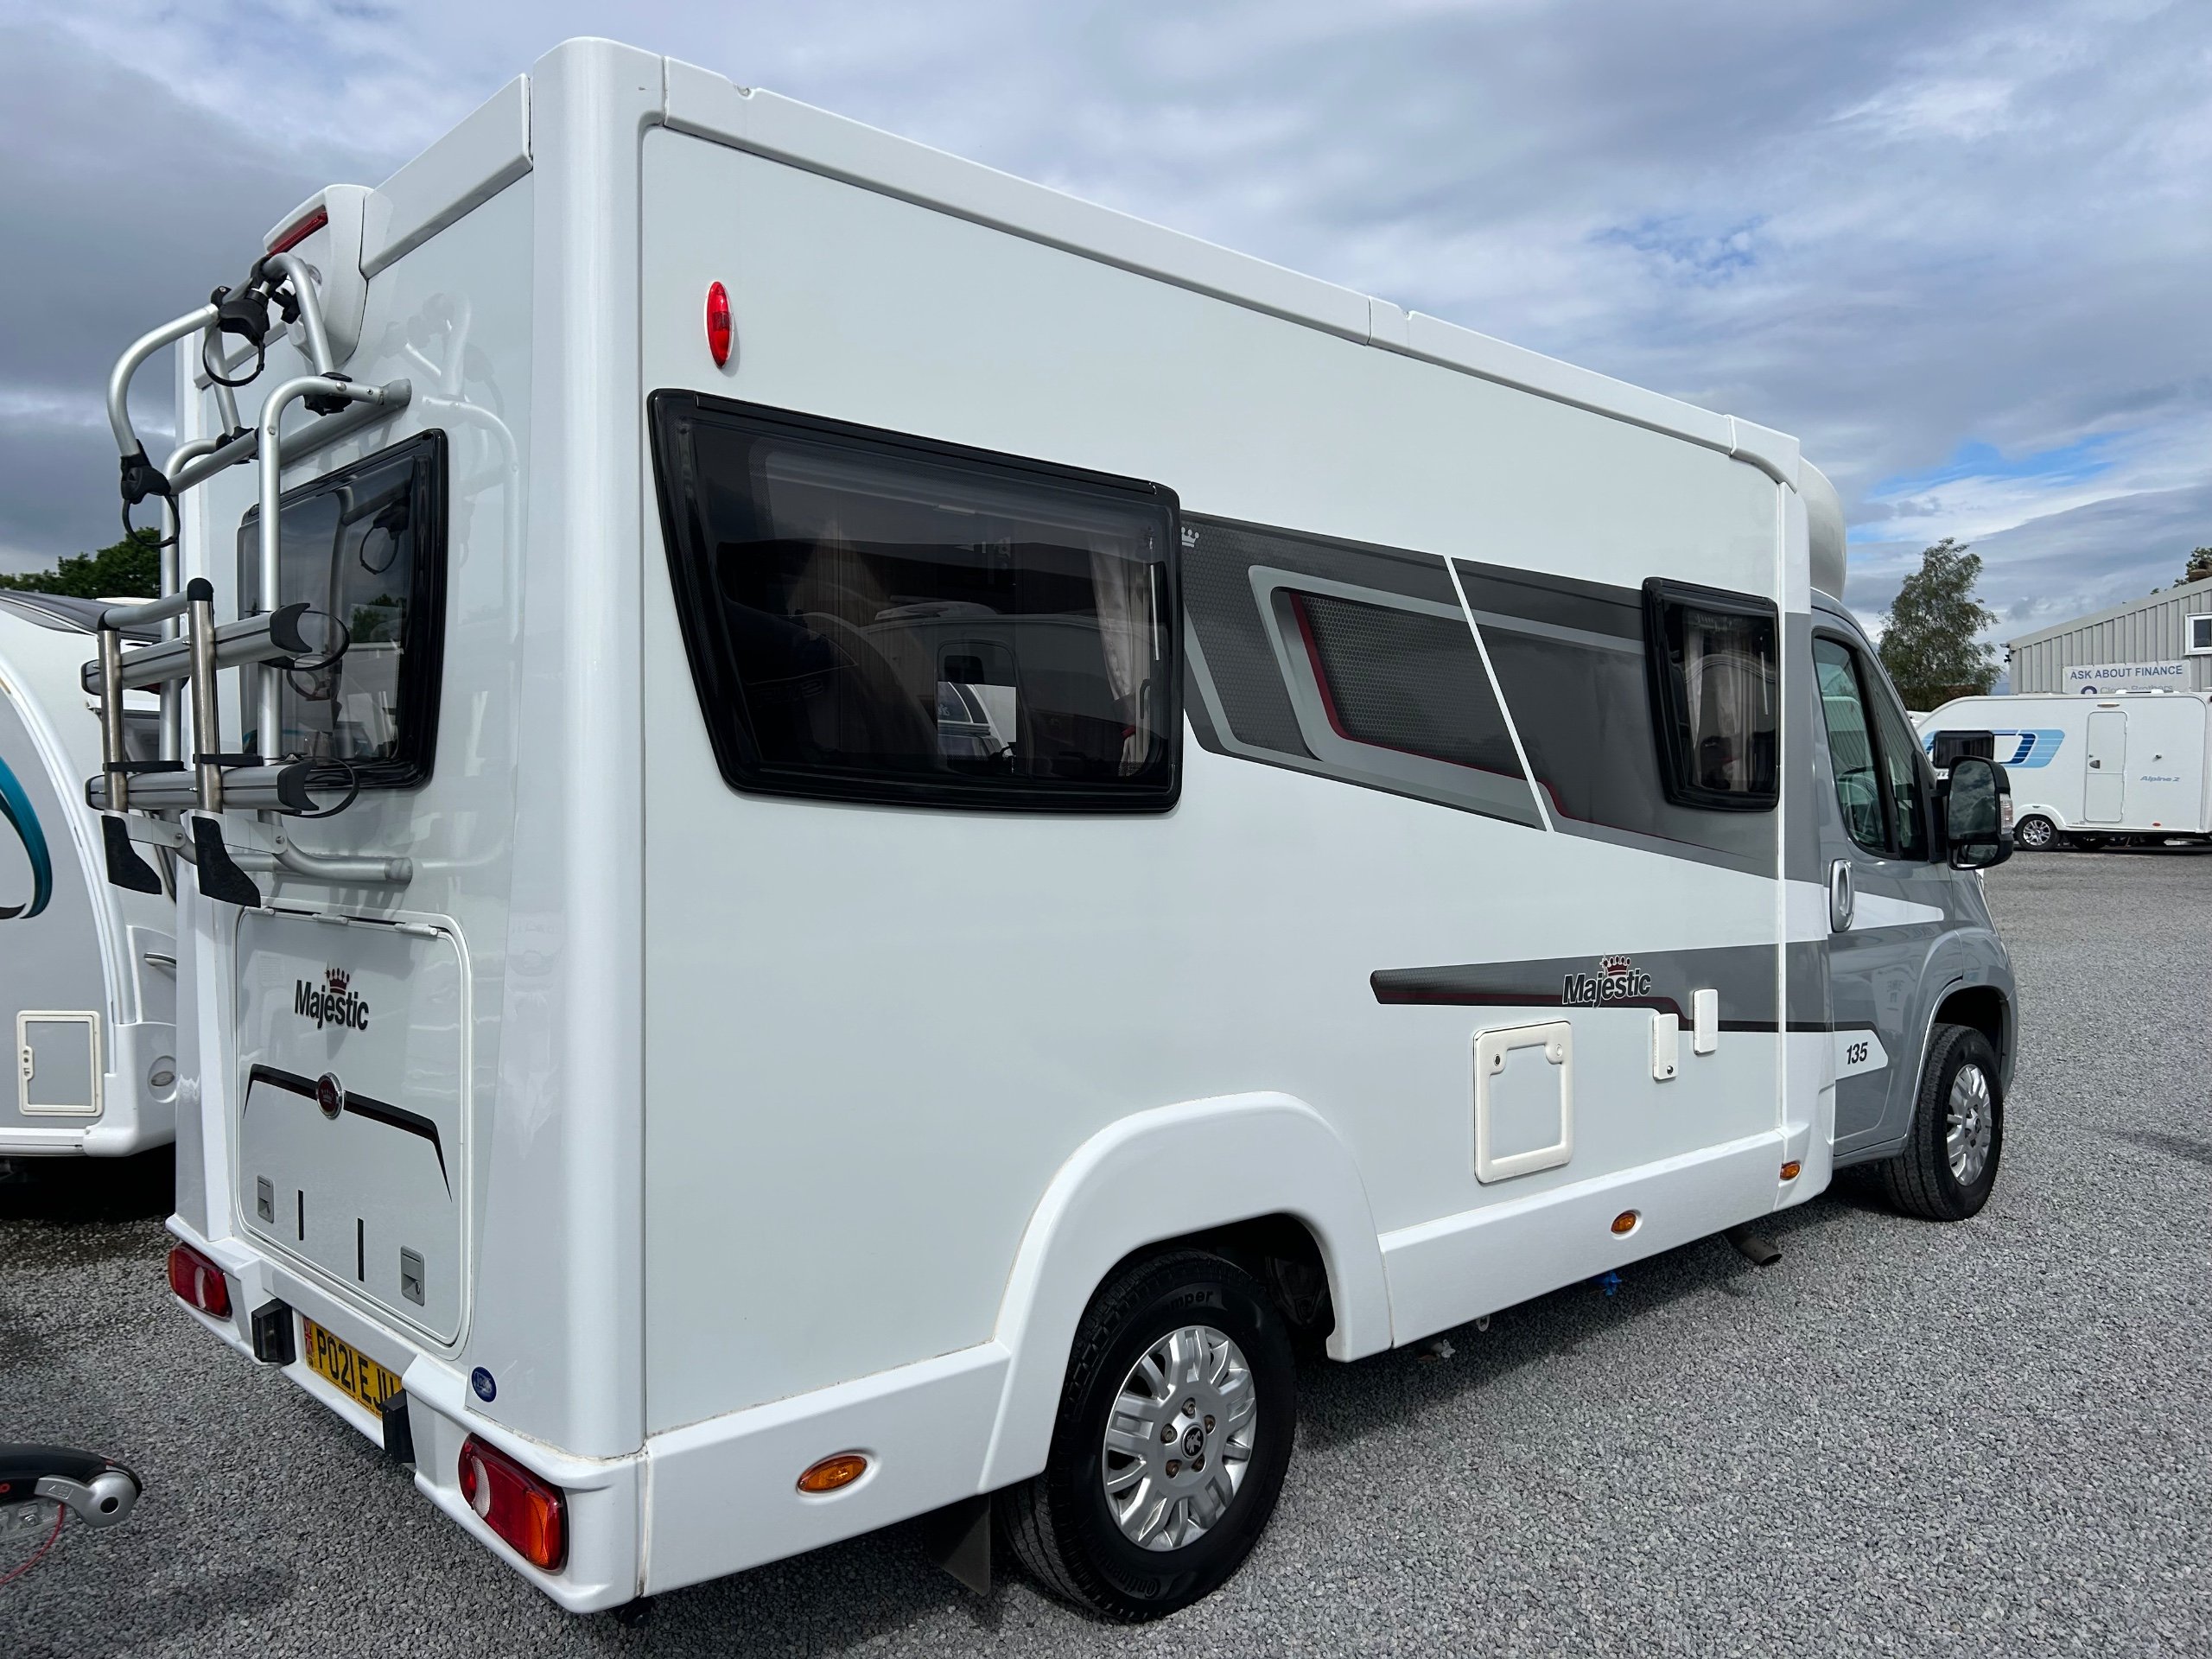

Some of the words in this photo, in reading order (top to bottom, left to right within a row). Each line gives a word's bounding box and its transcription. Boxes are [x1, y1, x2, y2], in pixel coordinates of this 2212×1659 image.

[2070, 671, 2092, 680] ASK
[2094, 668, 2132, 678] ABOUT
[2135, 665, 2183, 677] FINANCE
[295, 979, 369, 1031] Majestic
[1561, 967, 1651, 1007] Majestic
[1847, 1041, 1868, 1065] 135
[316, 1327, 356, 1393] PO21
